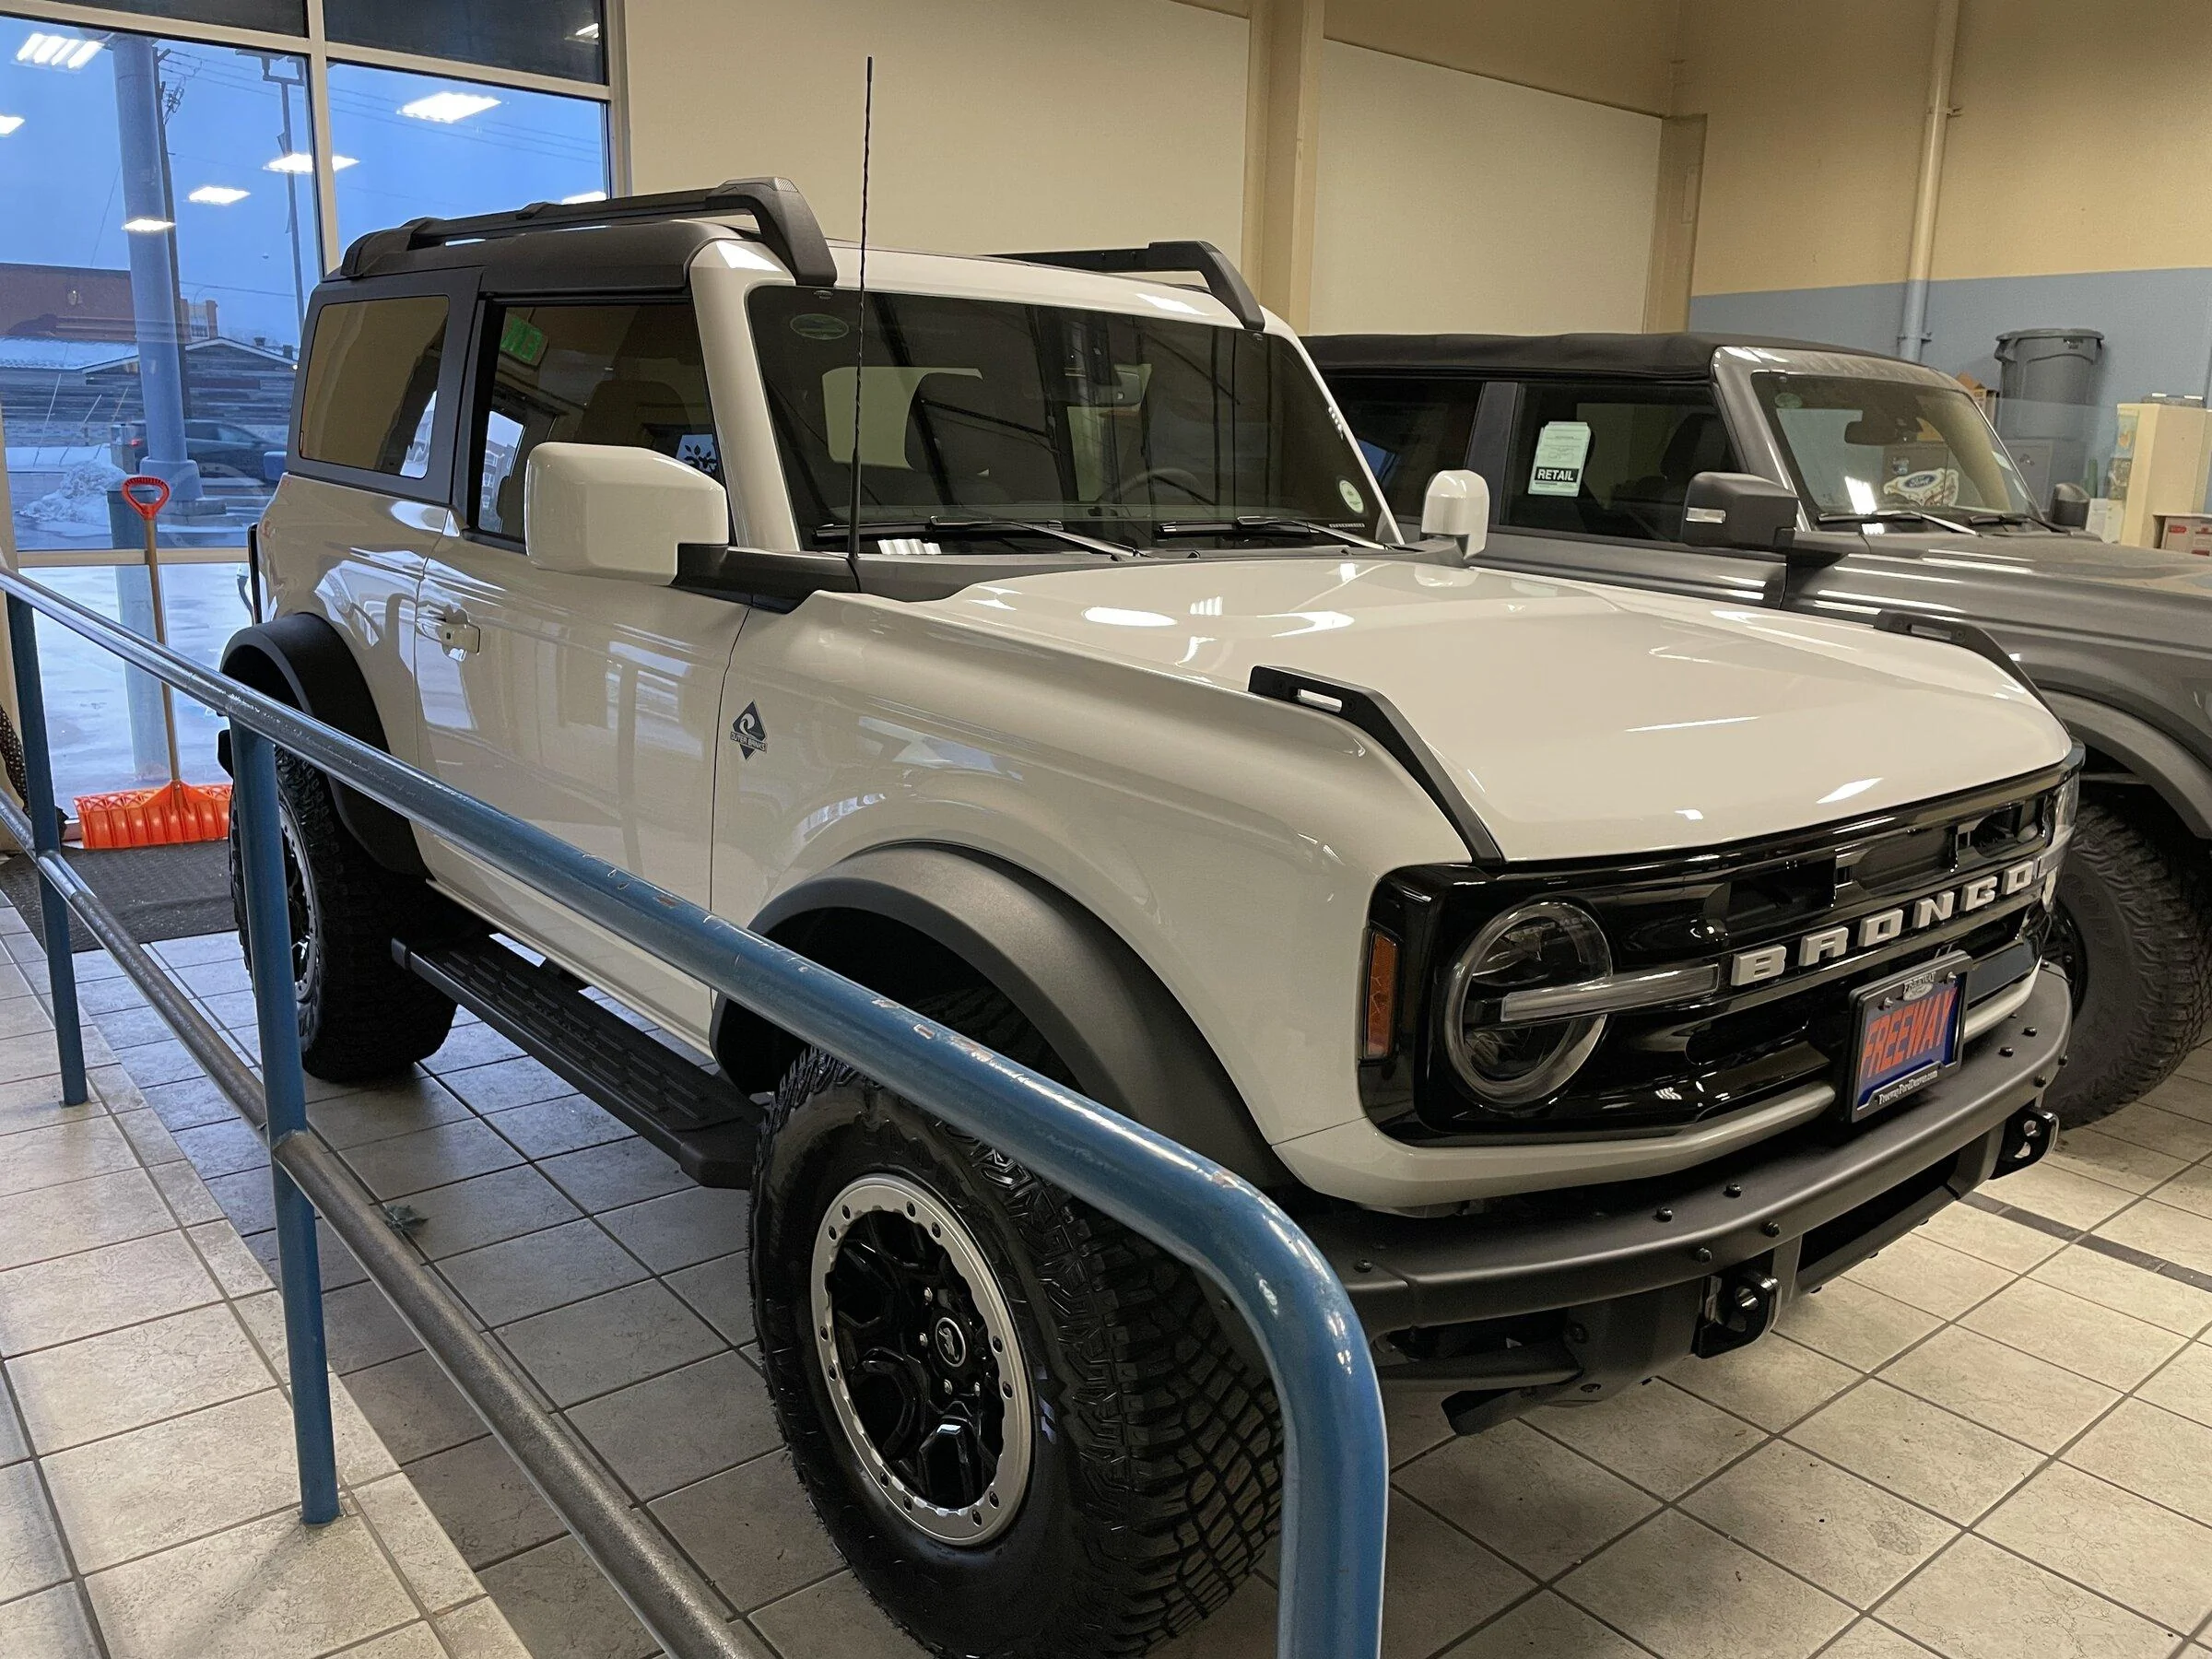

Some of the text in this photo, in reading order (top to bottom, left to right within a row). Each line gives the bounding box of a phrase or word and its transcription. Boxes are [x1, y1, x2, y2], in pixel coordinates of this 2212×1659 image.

[1537, 469, 1574, 481] RETAIL
[1731, 860, 2034, 986] BRONCO
[1861, 987, 1958, 1078] FREEWAY
